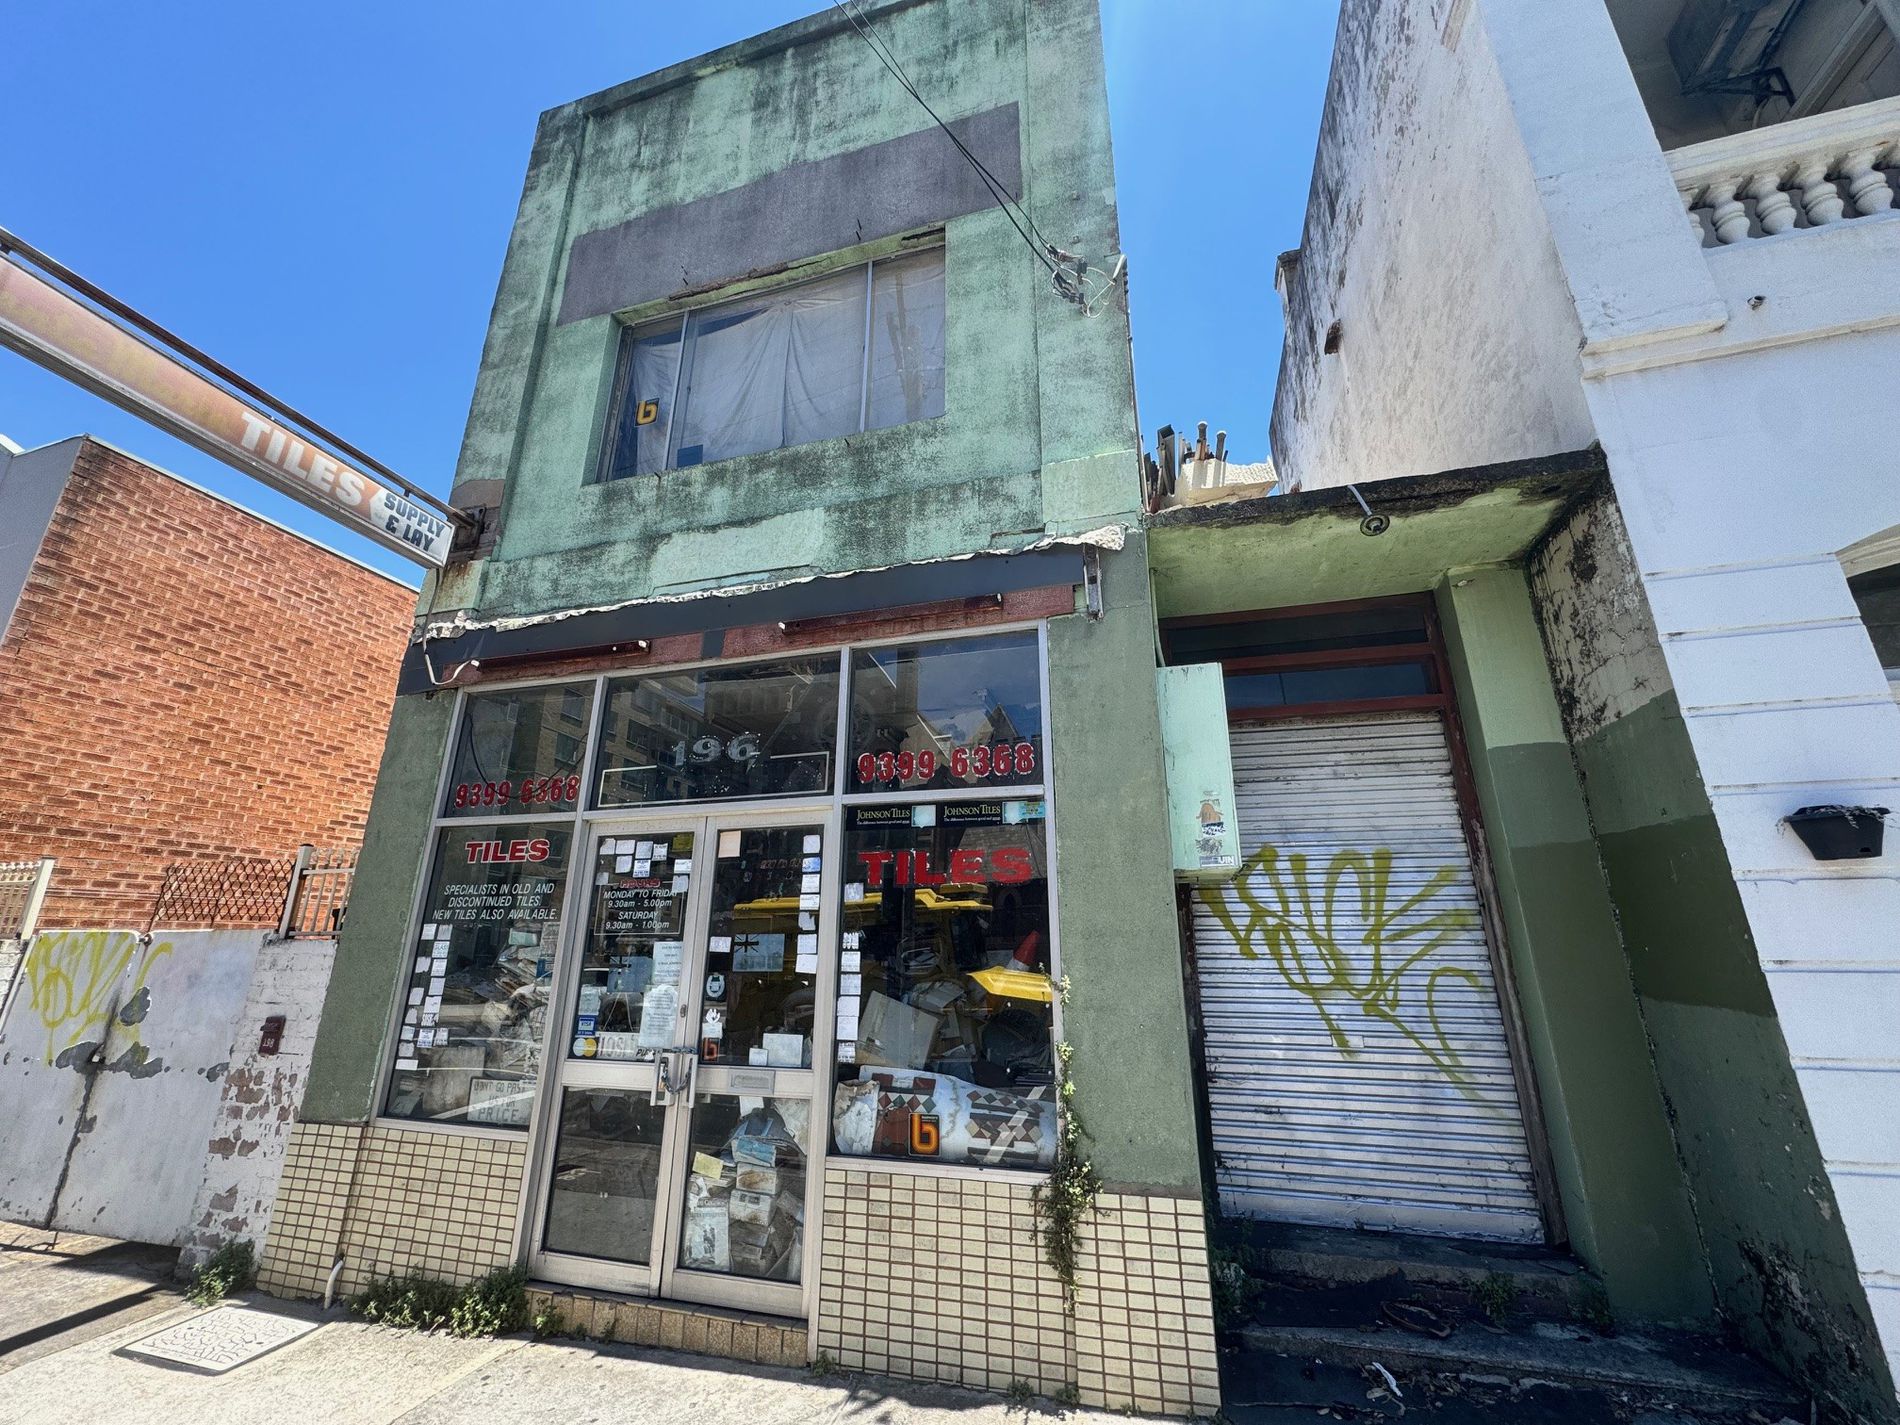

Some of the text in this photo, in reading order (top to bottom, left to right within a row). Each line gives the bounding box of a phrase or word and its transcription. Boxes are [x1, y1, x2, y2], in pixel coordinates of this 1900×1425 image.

[241, 411, 366, 506] TILES
[383, 492, 446, 538] SUPPLY
[385, 515, 435, 552] & LAY
[672, 731, 762, 767] 196
[857, 741, 1035, 784] 9399 6368
[454, 774, 580, 809] 9399 6368
[857, 808, 910, 820] JOHNSON TILES
[944, 804, 1001, 817] JOHNSON TILES
[465, 838, 550, 864] TILES
[858, 848, 1033, 886] TILES
[444, 883, 555, 895] SPECIALISTS IN OLD AND
[603, 889, 636, 899] MONDAY
[638, 889, 649, 898] TO
[448, 896, 513, 908] DISCONTINUED
[607, 900, 635, 908] 9.30am
[643, 899, 672, 908] 5.00pm
[432, 908, 558, 920] NEW TILES ALSO AVAILABLE.
[618, 911, 658, 920] SATURDAY
[605, 921, 633, 929] 9.30am
[642, 920, 669, 929] 1.00pm
[478, 1107, 519, 1123] PRICE
